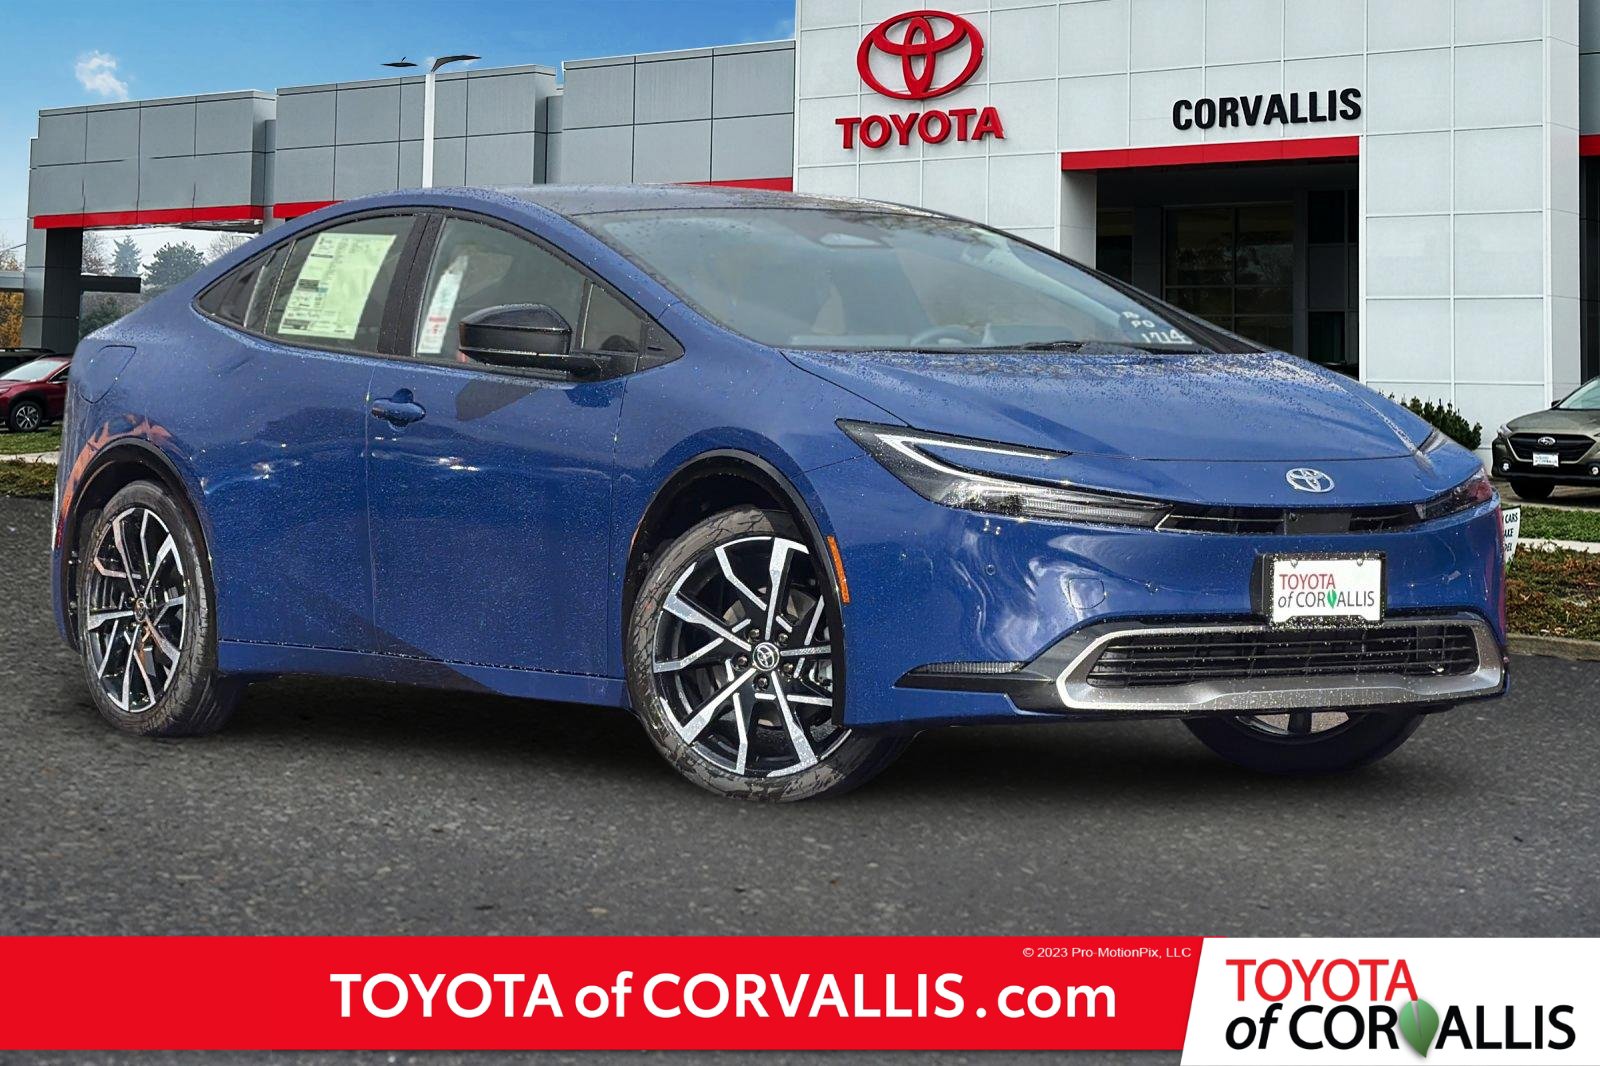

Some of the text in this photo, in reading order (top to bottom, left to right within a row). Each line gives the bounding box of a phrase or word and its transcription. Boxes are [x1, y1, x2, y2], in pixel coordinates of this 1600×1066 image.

[1172, 88, 1362, 130] CORVALLIS
[836, 107, 1004, 149] TOYOTA
[1279, 573, 1336, 590] TOYOTA
[1277, 591, 1293, 608] of
